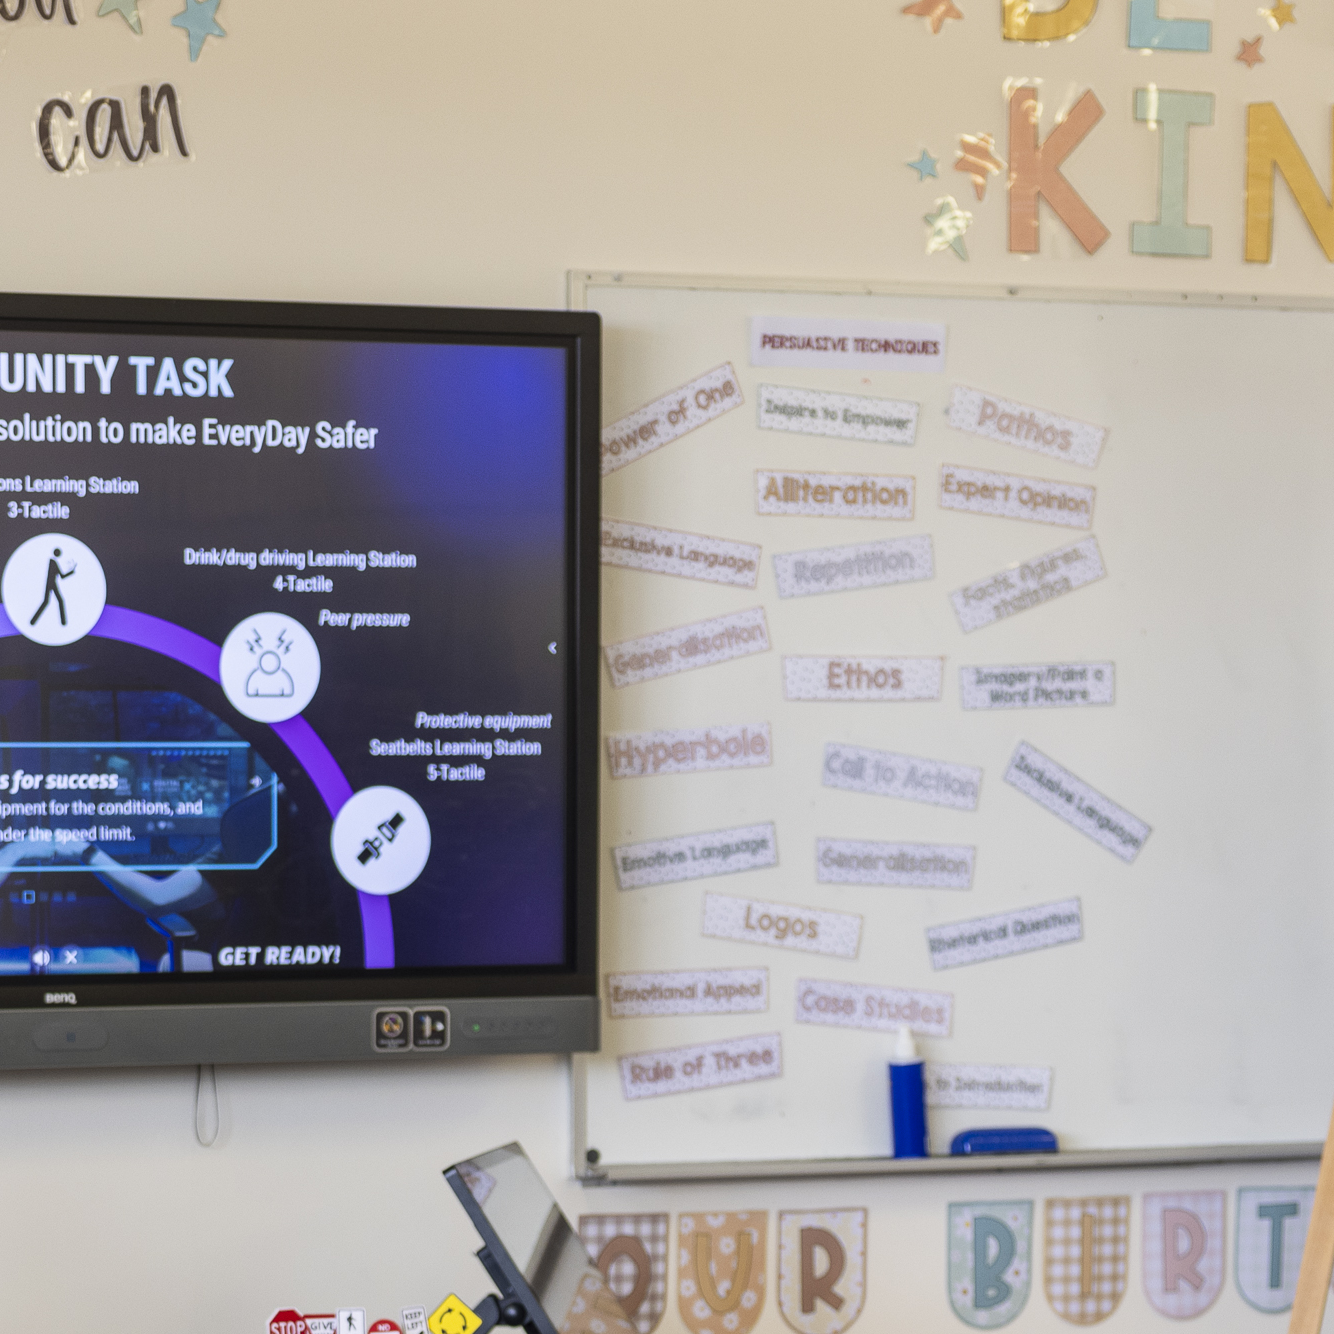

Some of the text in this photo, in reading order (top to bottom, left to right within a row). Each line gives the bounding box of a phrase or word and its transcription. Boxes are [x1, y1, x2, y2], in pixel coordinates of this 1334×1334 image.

[39, 83, 189, 172] can
[761, 333, 941, 356] PERSUASIVE TECHNIQUES
[128, 355, 235, 398] TASK
[667, 379, 736, 426] of One
[97, 416, 124, 445] to
[130, 414, 196, 446] make
[202, 417, 310, 454] EveryDay
[315, 420, 379, 450] Safer
[977, 398, 1074, 452] Pathos
[25, 475, 87, 497] Learning
[88, 475, 139, 494] Station
[763, 476, 910, 507] Alliteration
[943, 473, 1091, 515] Expert Opinion
[7, 501, 70, 519] 3-Tactile
[183, 547, 417, 571] Drink/drug driving Learning Station
[273, 574, 333, 593] 4-Tactile
[318, 608, 410, 630] Peer pressure
[826, 660, 904, 691] Ethos
[415, 711, 553, 732] Protective equipment
[369, 738, 542, 759] Seatbelts Learning Station
[615, 728, 767, 774] Hyperbole
[11, 769, 42, 794] for
[45, 773, 119, 791] success
[427, 763, 486, 782] 5-Tactile
[49, 799, 70, 816] for
[71, 799, 96, 816] the
[97, 798, 174, 819] conditions,
[175, 798, 204, 815] and
[28, 825, 53, 842] the
[55, 825, 97, 845] speed
[98, 824, 136, 842] limit.
[744, 902, 819, 941] Logos
[218, 945, 342, 969] GET READY!
[800, 990, 946, 1025] Case Studies
[630, 1049, 774, 1085] Rule of Three
[597, 1226, 846, 1317] OUR
[310, 1321, 336, 1331] GIVE
[377, 1324, 391, 1332] NO
[405, 1311, 423, 1321] KEEP
[407, 1320, 424, 1331] LEFT
